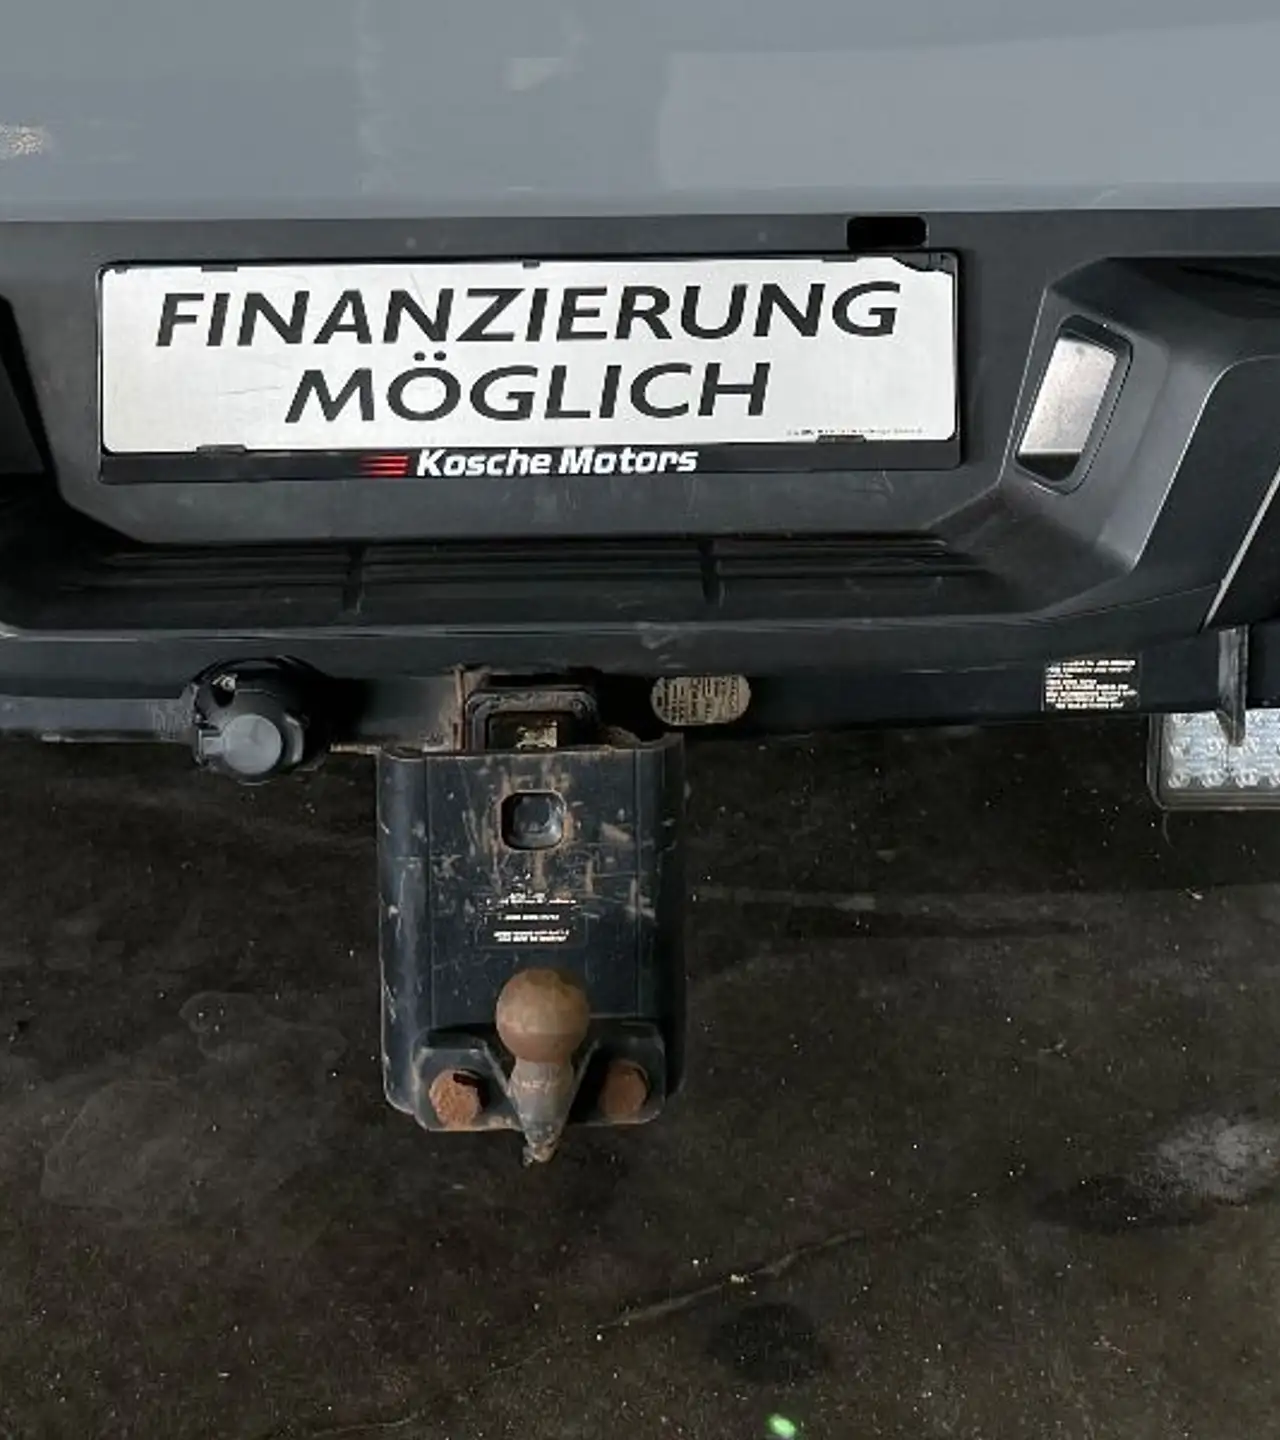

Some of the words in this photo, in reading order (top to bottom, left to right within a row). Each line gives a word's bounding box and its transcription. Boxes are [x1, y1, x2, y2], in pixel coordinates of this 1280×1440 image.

[155, 280, 902, 348] FINANZIERUNG
[284, 351, 771, 424] MÖGLICH
[416, 447, 552, 478] Kosche
[558, 446, 699, 474] Motors
